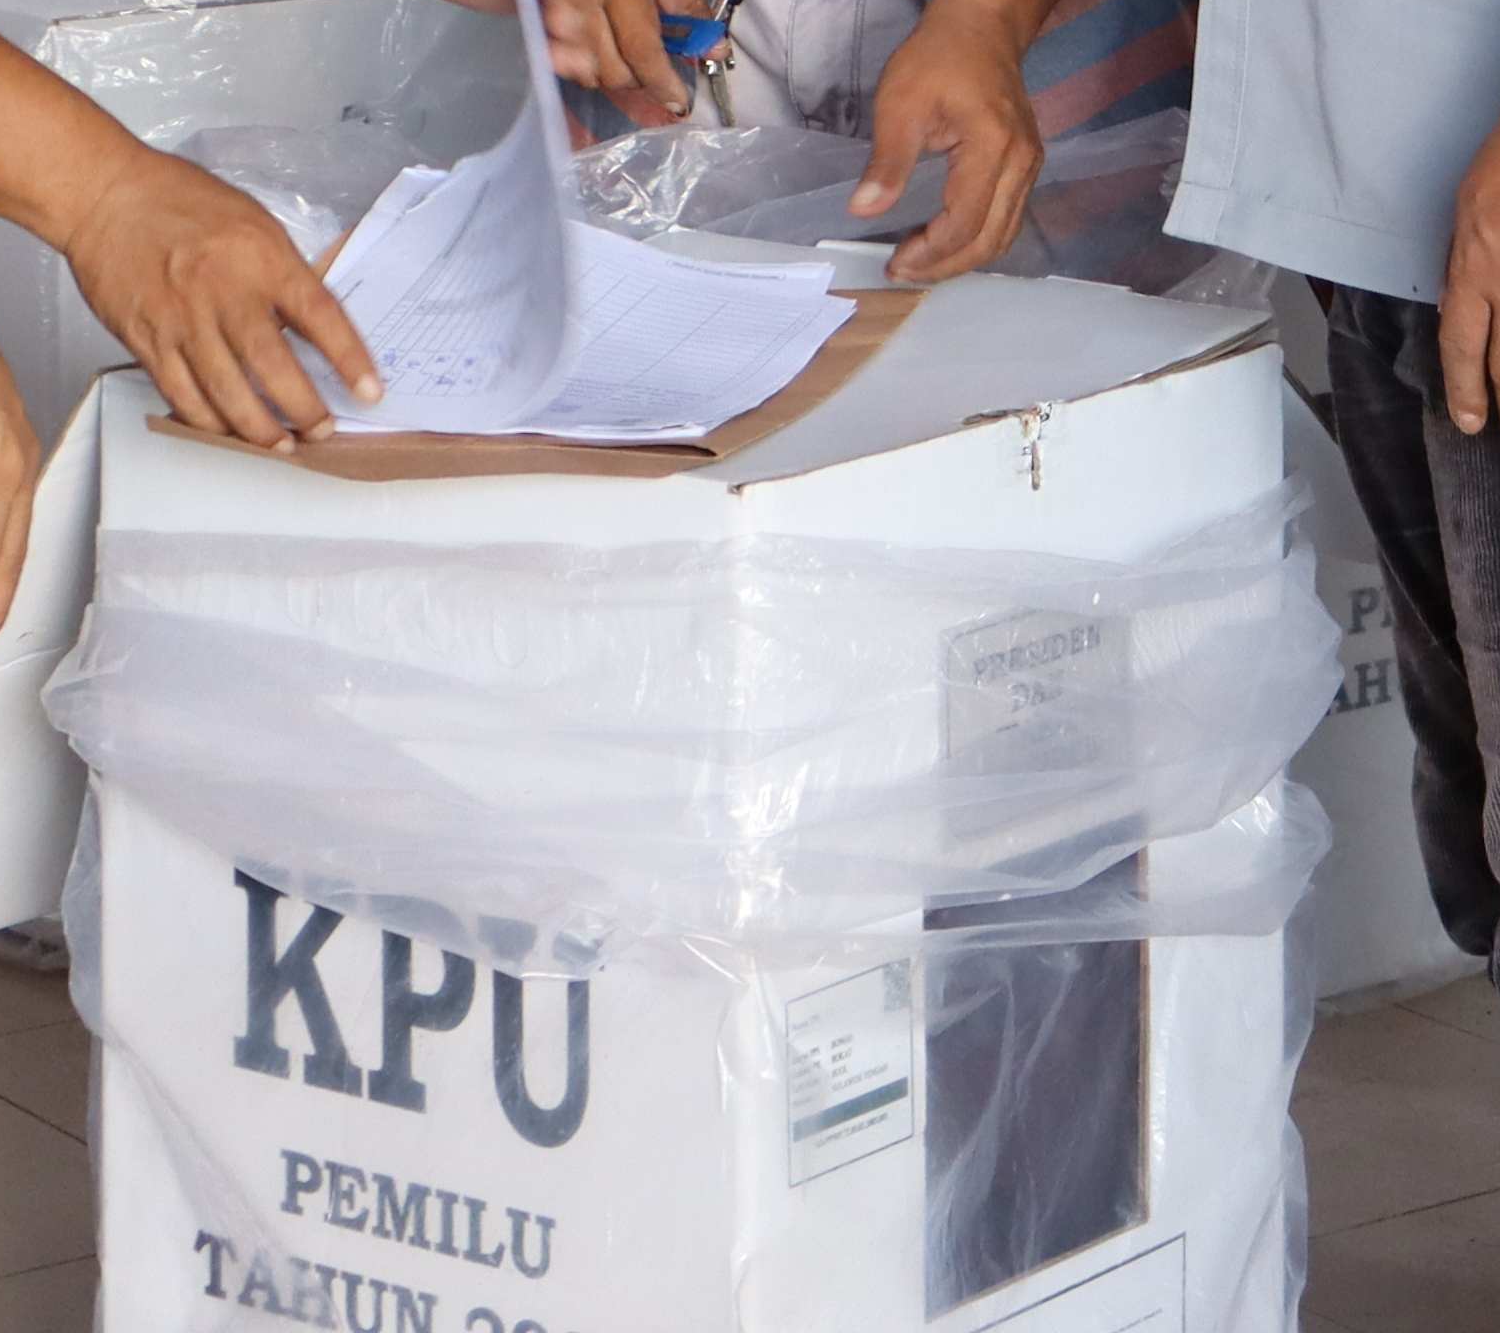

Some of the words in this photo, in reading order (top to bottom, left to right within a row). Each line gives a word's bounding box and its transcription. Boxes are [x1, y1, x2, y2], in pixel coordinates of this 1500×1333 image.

[232, 861, 608, 1148] KPU
[279, 1149, 556, 1279] PEMILU
[193, 1230, 440, 1333] TAHUN
